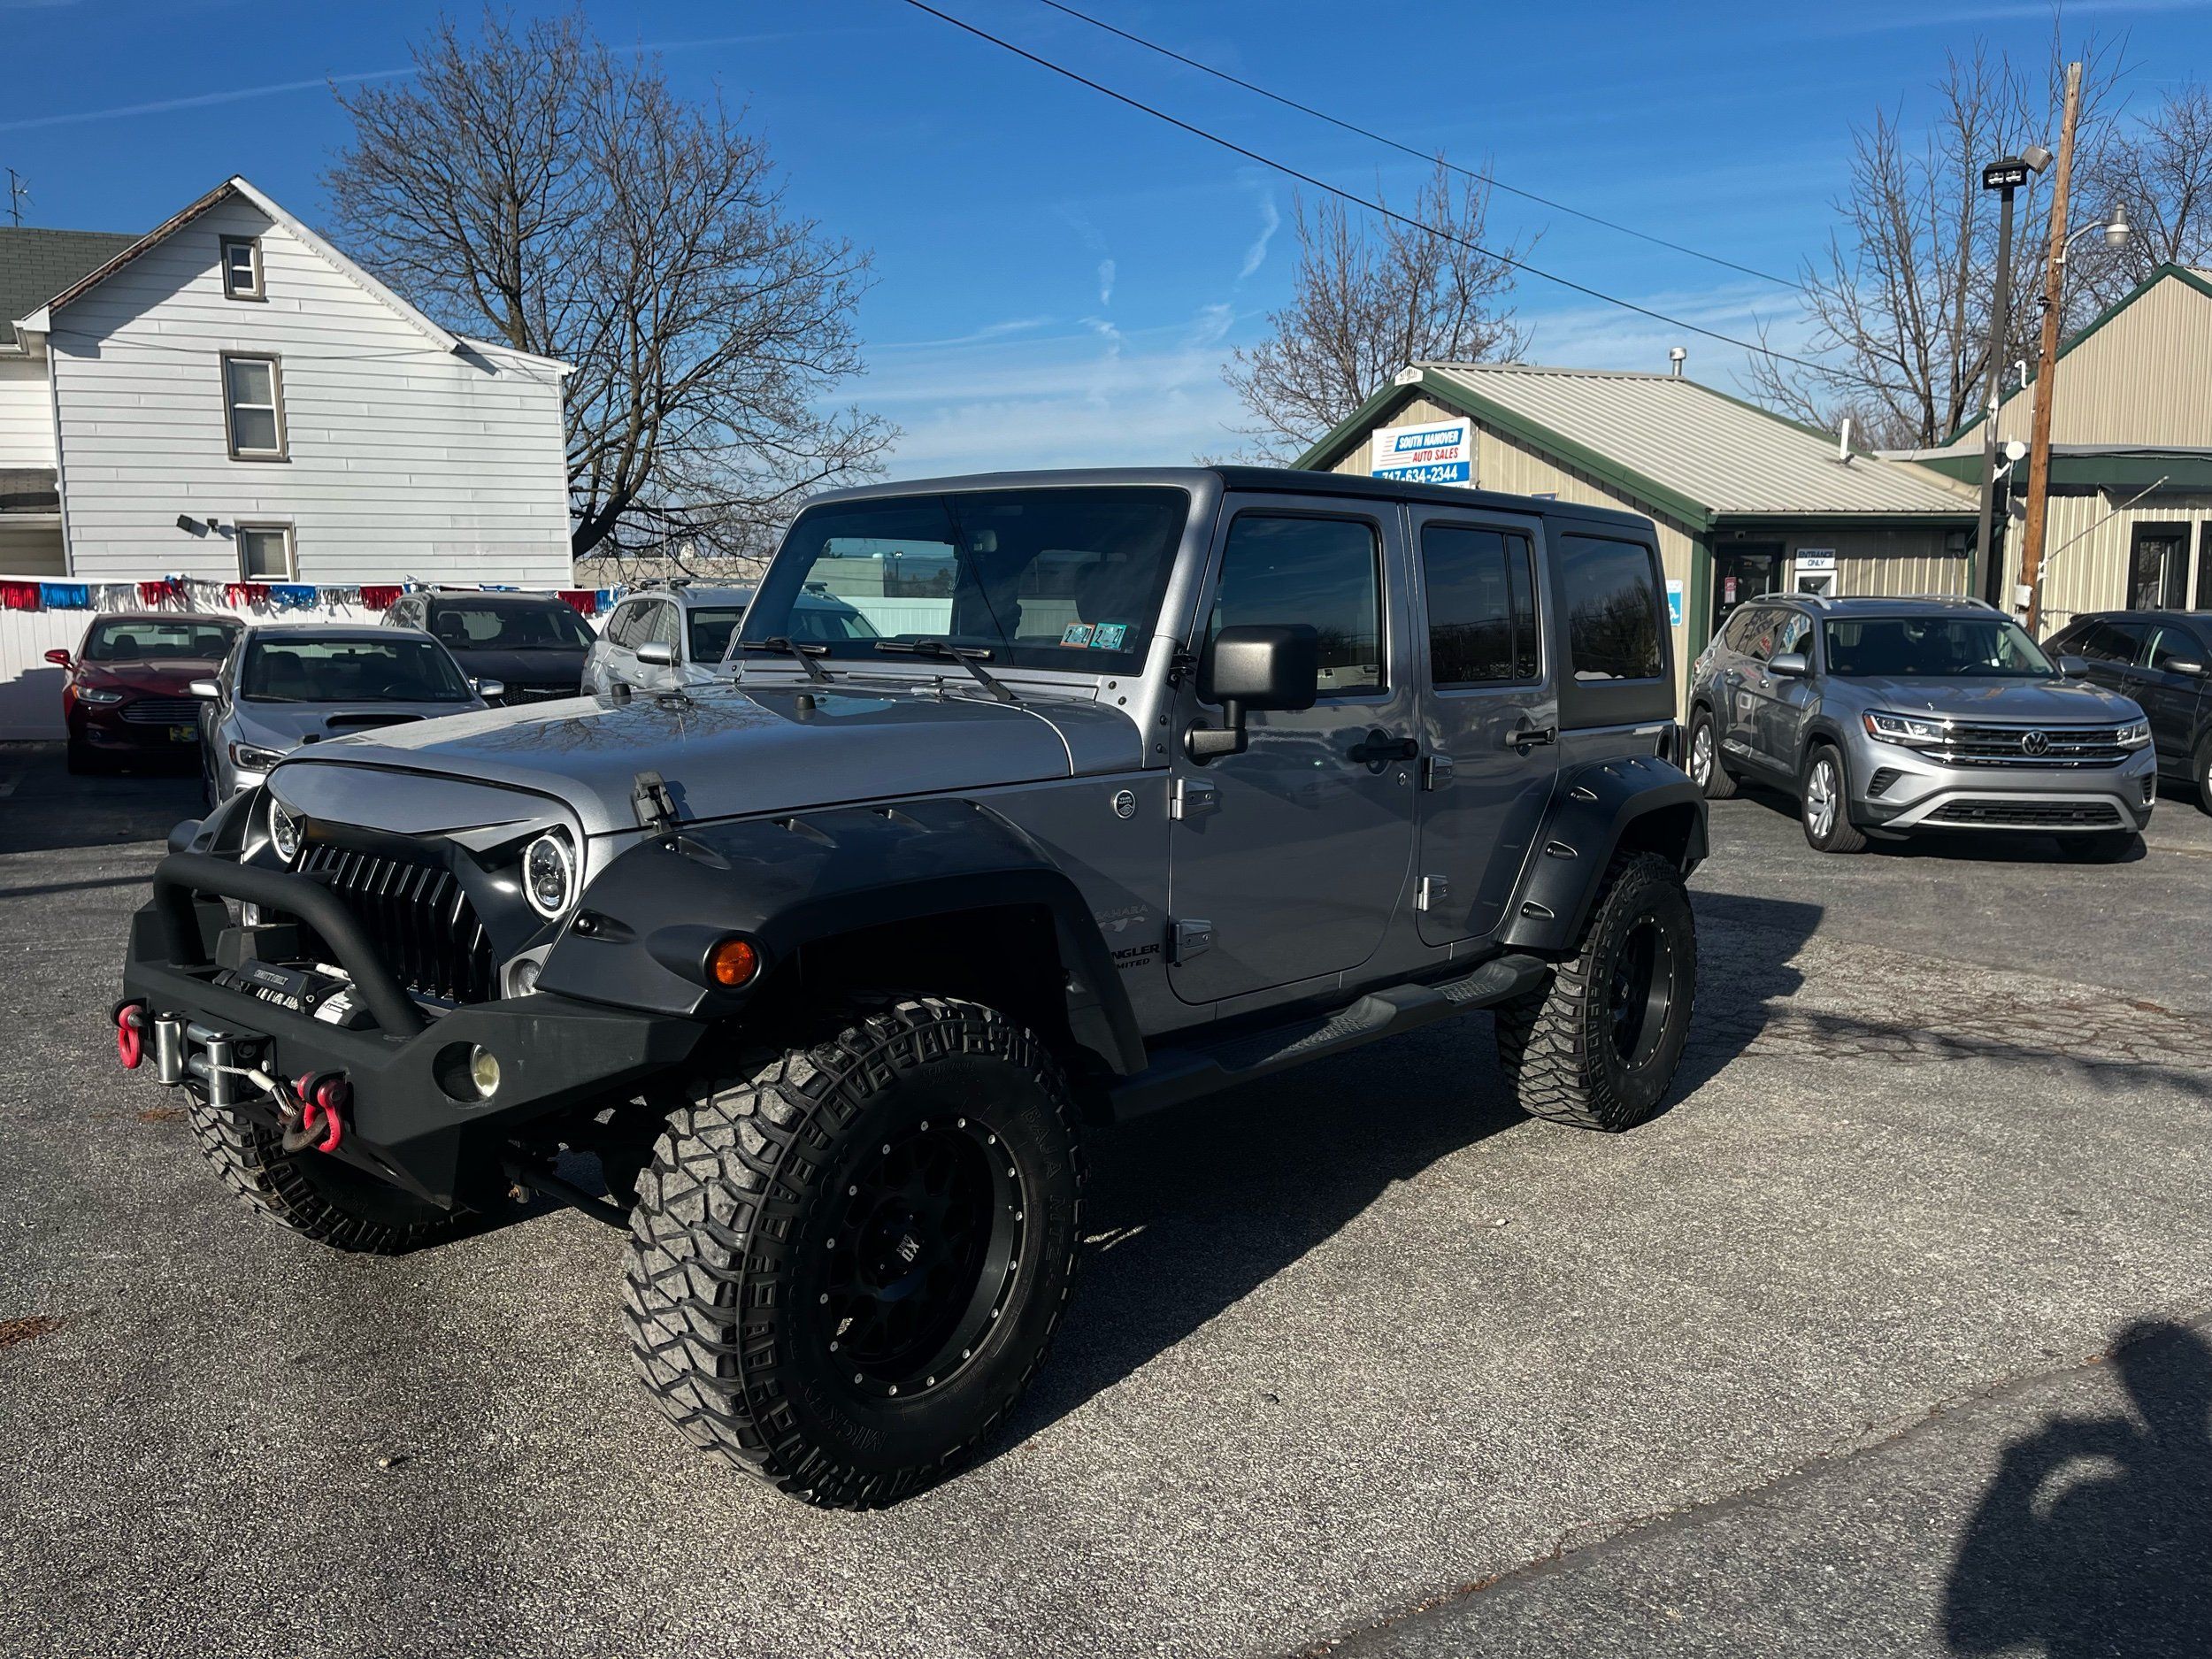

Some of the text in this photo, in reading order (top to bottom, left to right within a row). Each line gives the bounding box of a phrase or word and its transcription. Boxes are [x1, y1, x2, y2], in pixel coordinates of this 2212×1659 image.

[1399, 430, 1459, 449] SOUTH HANOVER
[1412, 447, 1459, 463] AUTO SALES
[1382, 465, 1458, 483] 717-634-2344
[1111, 943, 1161, 960] NGLER
[1117, 957, 1150, 969] MITED
[1020, 1104, 1062, 1181] BAJA
